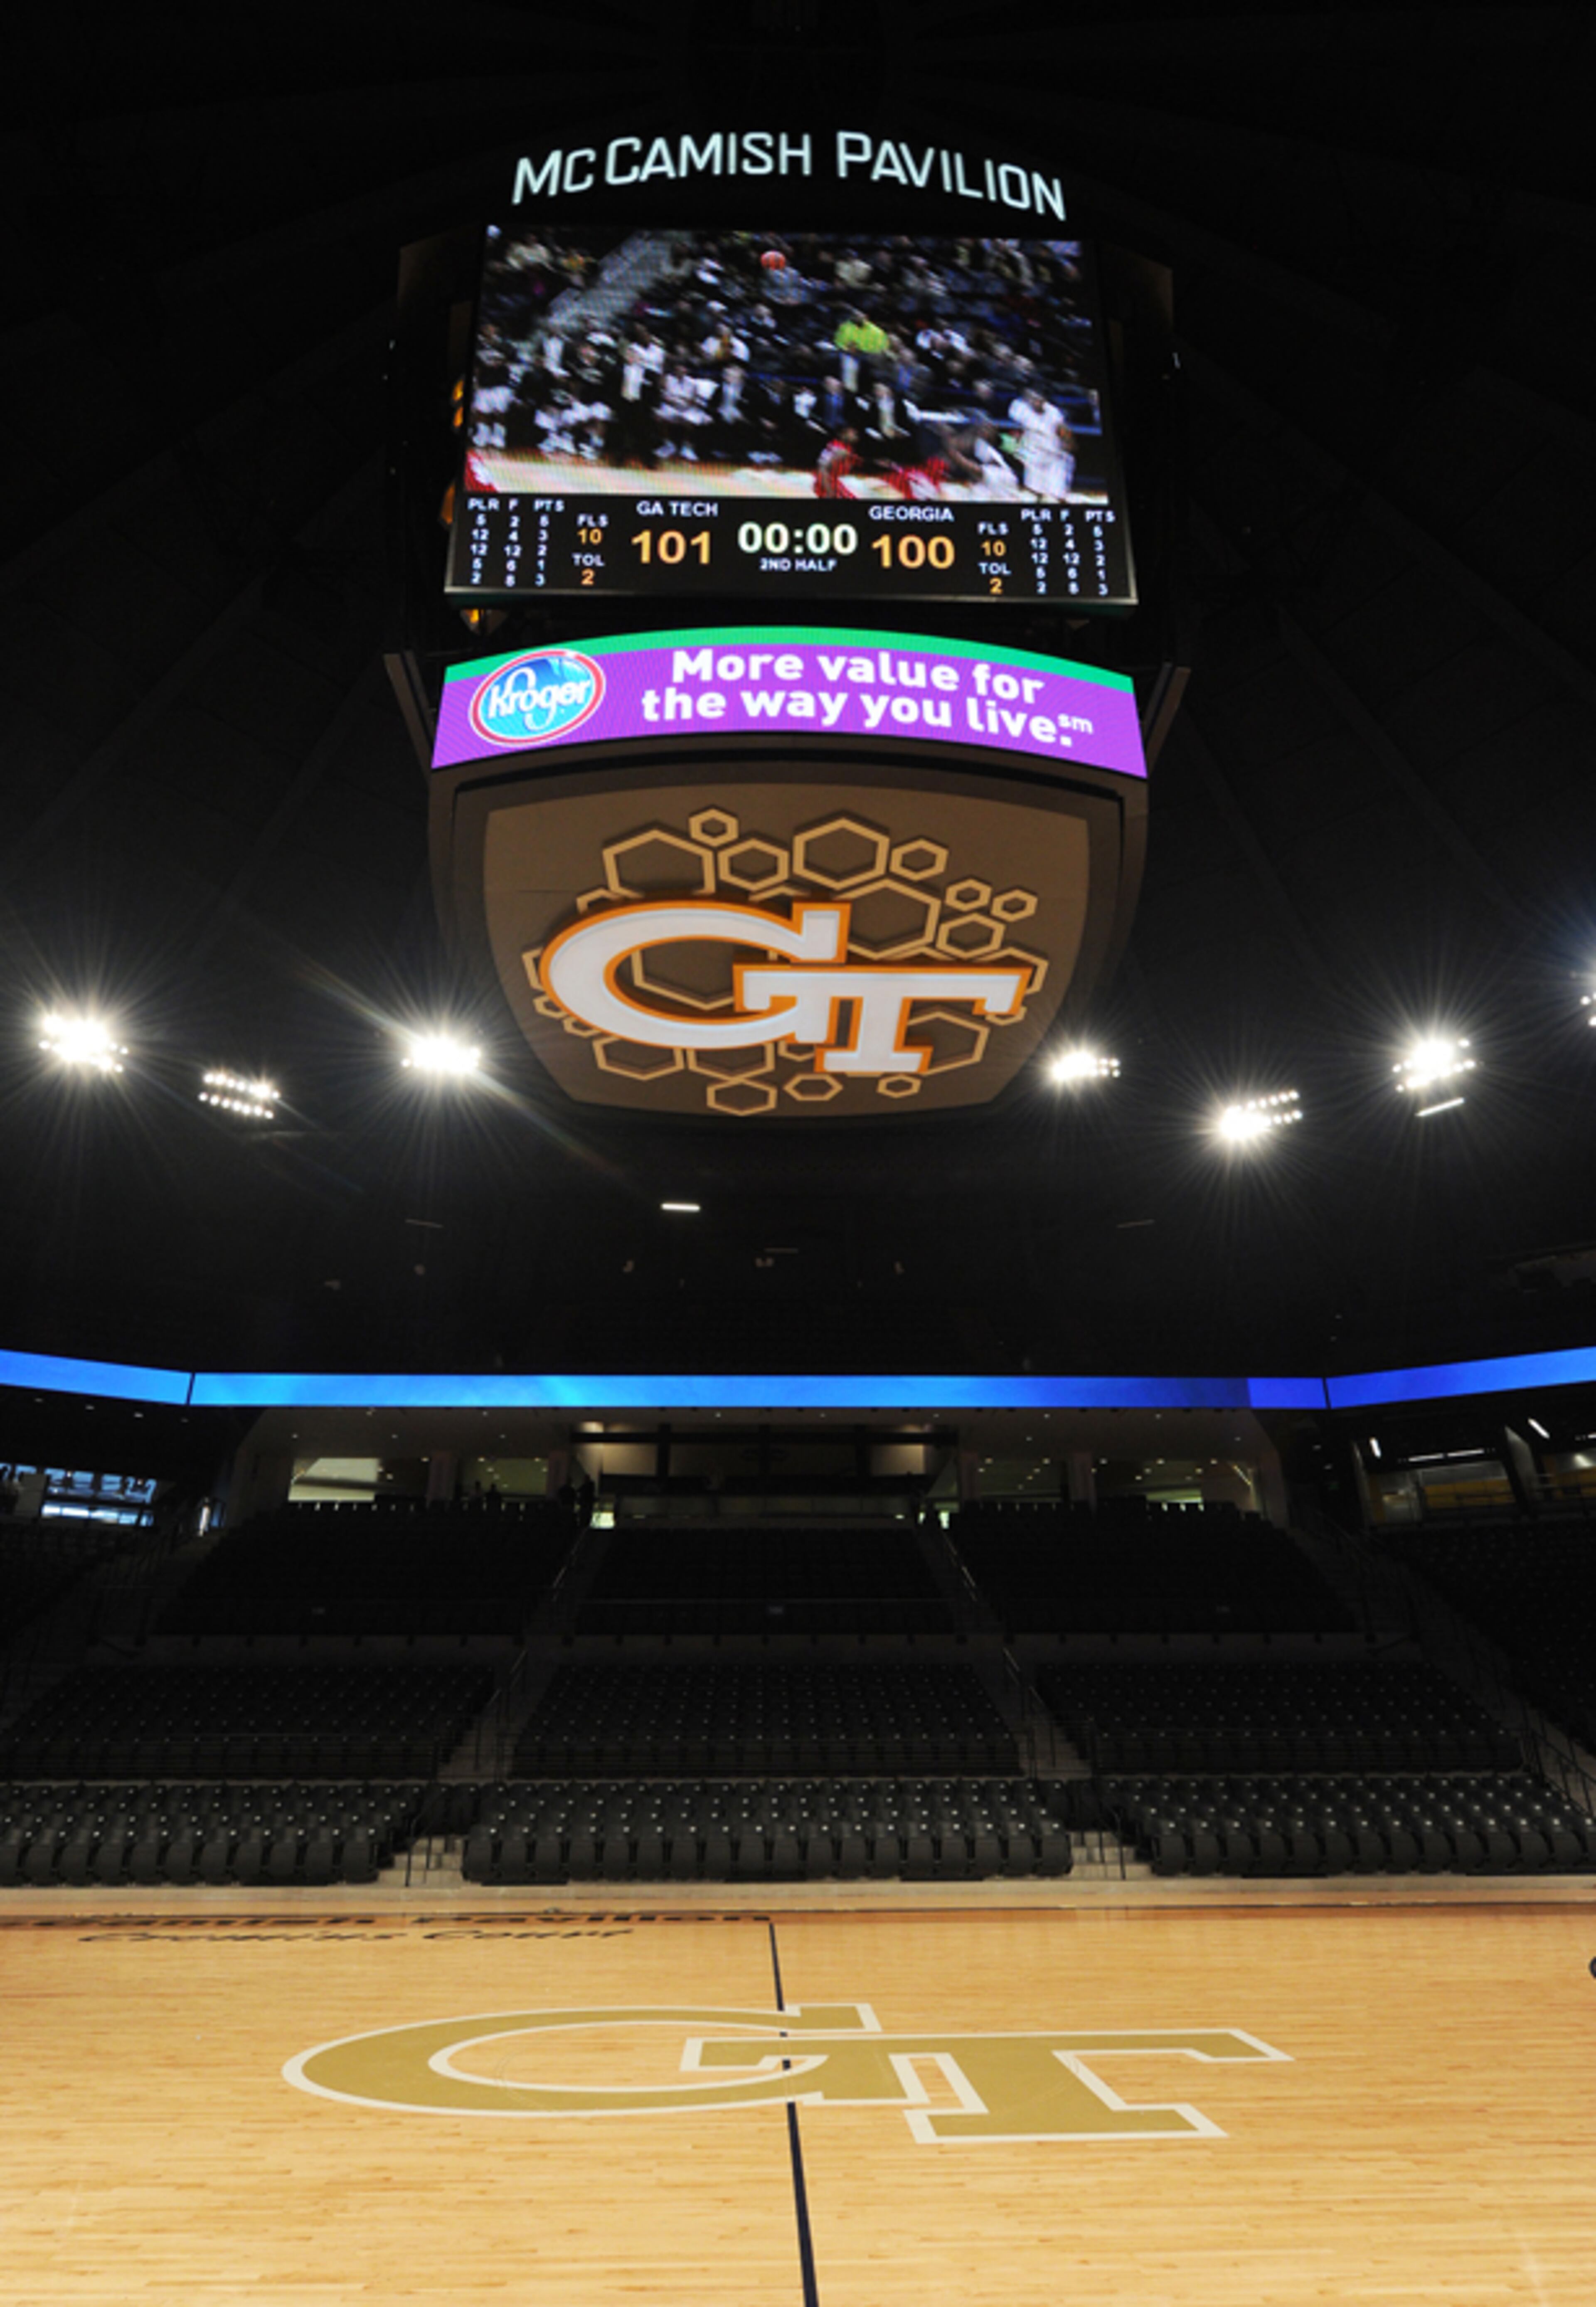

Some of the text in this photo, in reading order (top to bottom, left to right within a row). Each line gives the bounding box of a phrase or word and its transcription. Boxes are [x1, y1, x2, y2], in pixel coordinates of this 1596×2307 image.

[836, 130, 1066, 222] PAVILION
[467, 497, 565, 512] PLR F PTS
[636, 500, 719, 517] GA TECH
[510, 515, 520, 528] 2
[576, 513, 608, 530] FLS
[868, 505, 955, 522] GEORGIA
[1020, 508, 1116, 523] PLR F PTS
[471, 528, 548, 542] 12 4 3
[578, 528, 602, 545] 10
[978, 521, 1009, 535] FLS
[1064, 523, 1074, 536] 2
[737, 521, 858, 555] 00:00
[1030, 537, 1105, 552] 12 4 3
[470, 542, 547, 558] 12 12 2
[631, 529, 710, 565] 101
[872, 534, 955, 569] 100
[981, 540, 1006, 557] 10
[537, 558, 545, 571] 1
[572, 552, 605, 567] TOL
[759, 557, 837, 572] 2ND HALF
[1031, 552, 1106, 567] 12 12 2
[581, 568, 595, 586] 2
[978, 561, 1012, 576] TOL
[1097, 569, 1106, 581] 1
[470, 570, 482, 585] 2
[535, 573, 545, 587] 3
[989, 577, 1002, 594] 2
[1037, 580, 1047, 594] 2
[1098, 583, 1108, 596] 3
[672, 649, 1045, 704] More value for
[487, 666, 592, 732] Kroger
[642, 686, 726, 721] the
[741, 691, 849, 726] way
[860, 692, 954, 728] you
[539, 898, 1033, 1075] GT
[281, 2003, 1296, 2143] GT
